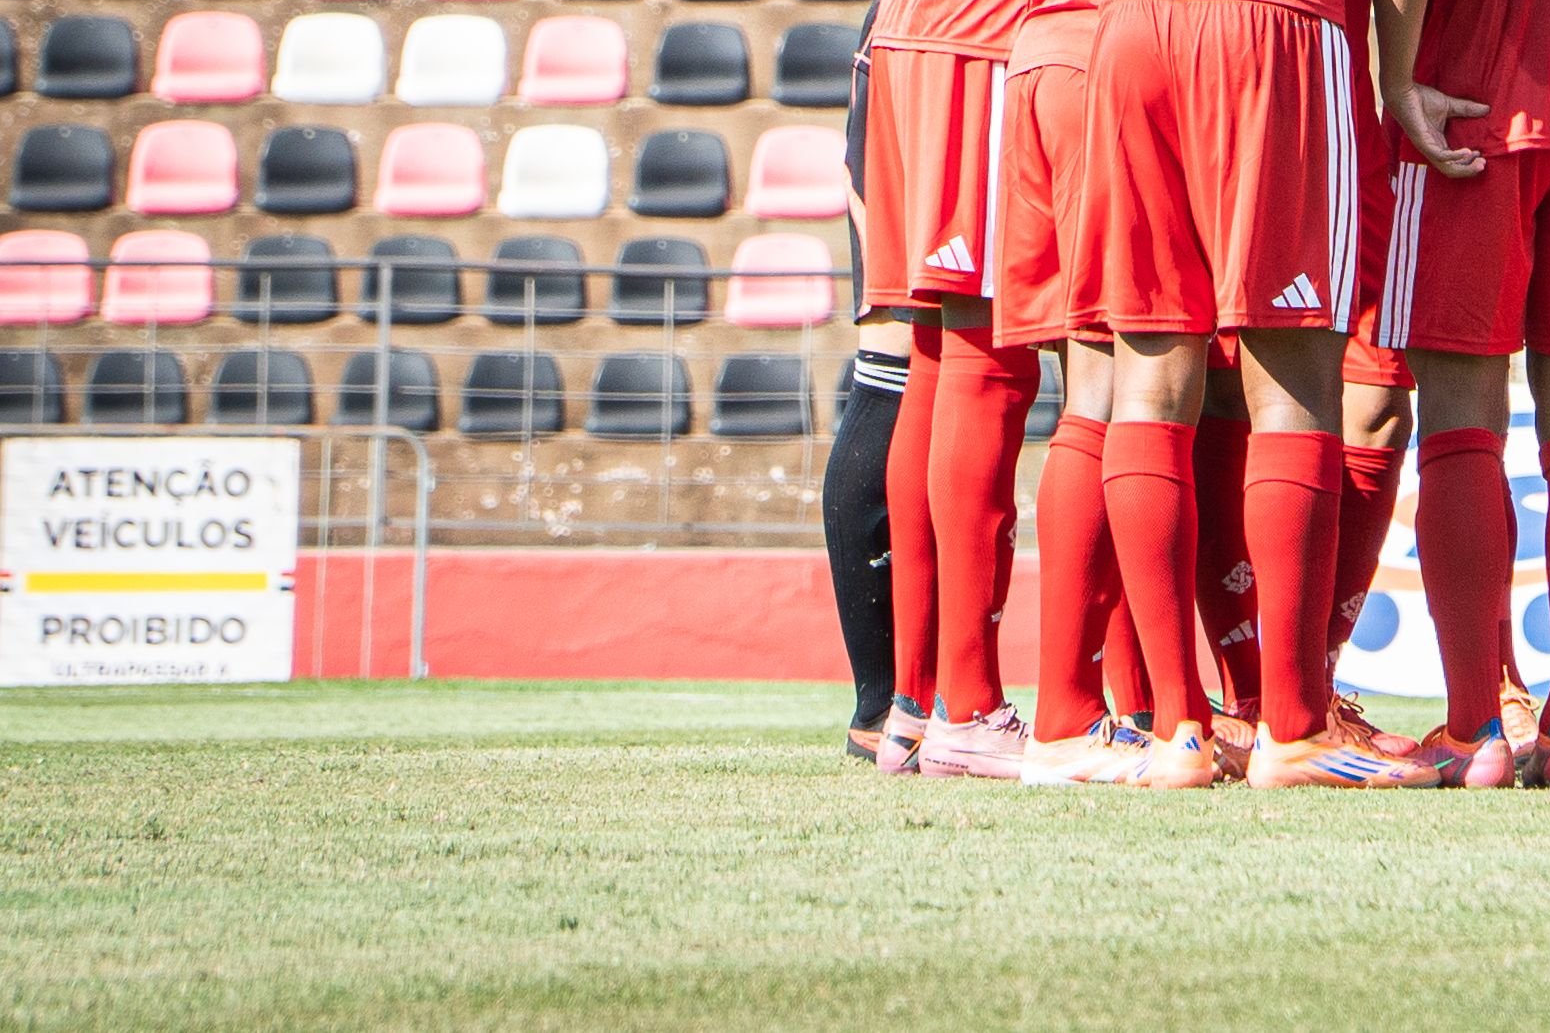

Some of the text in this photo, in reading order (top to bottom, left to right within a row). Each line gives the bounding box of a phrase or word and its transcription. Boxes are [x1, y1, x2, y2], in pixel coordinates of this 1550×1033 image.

[49, 459, 252, 507] ATENÇÃO
[42, 510, 254, 549] VEÍCULOS
[40, 614, 247, 645] PROIBIDO
